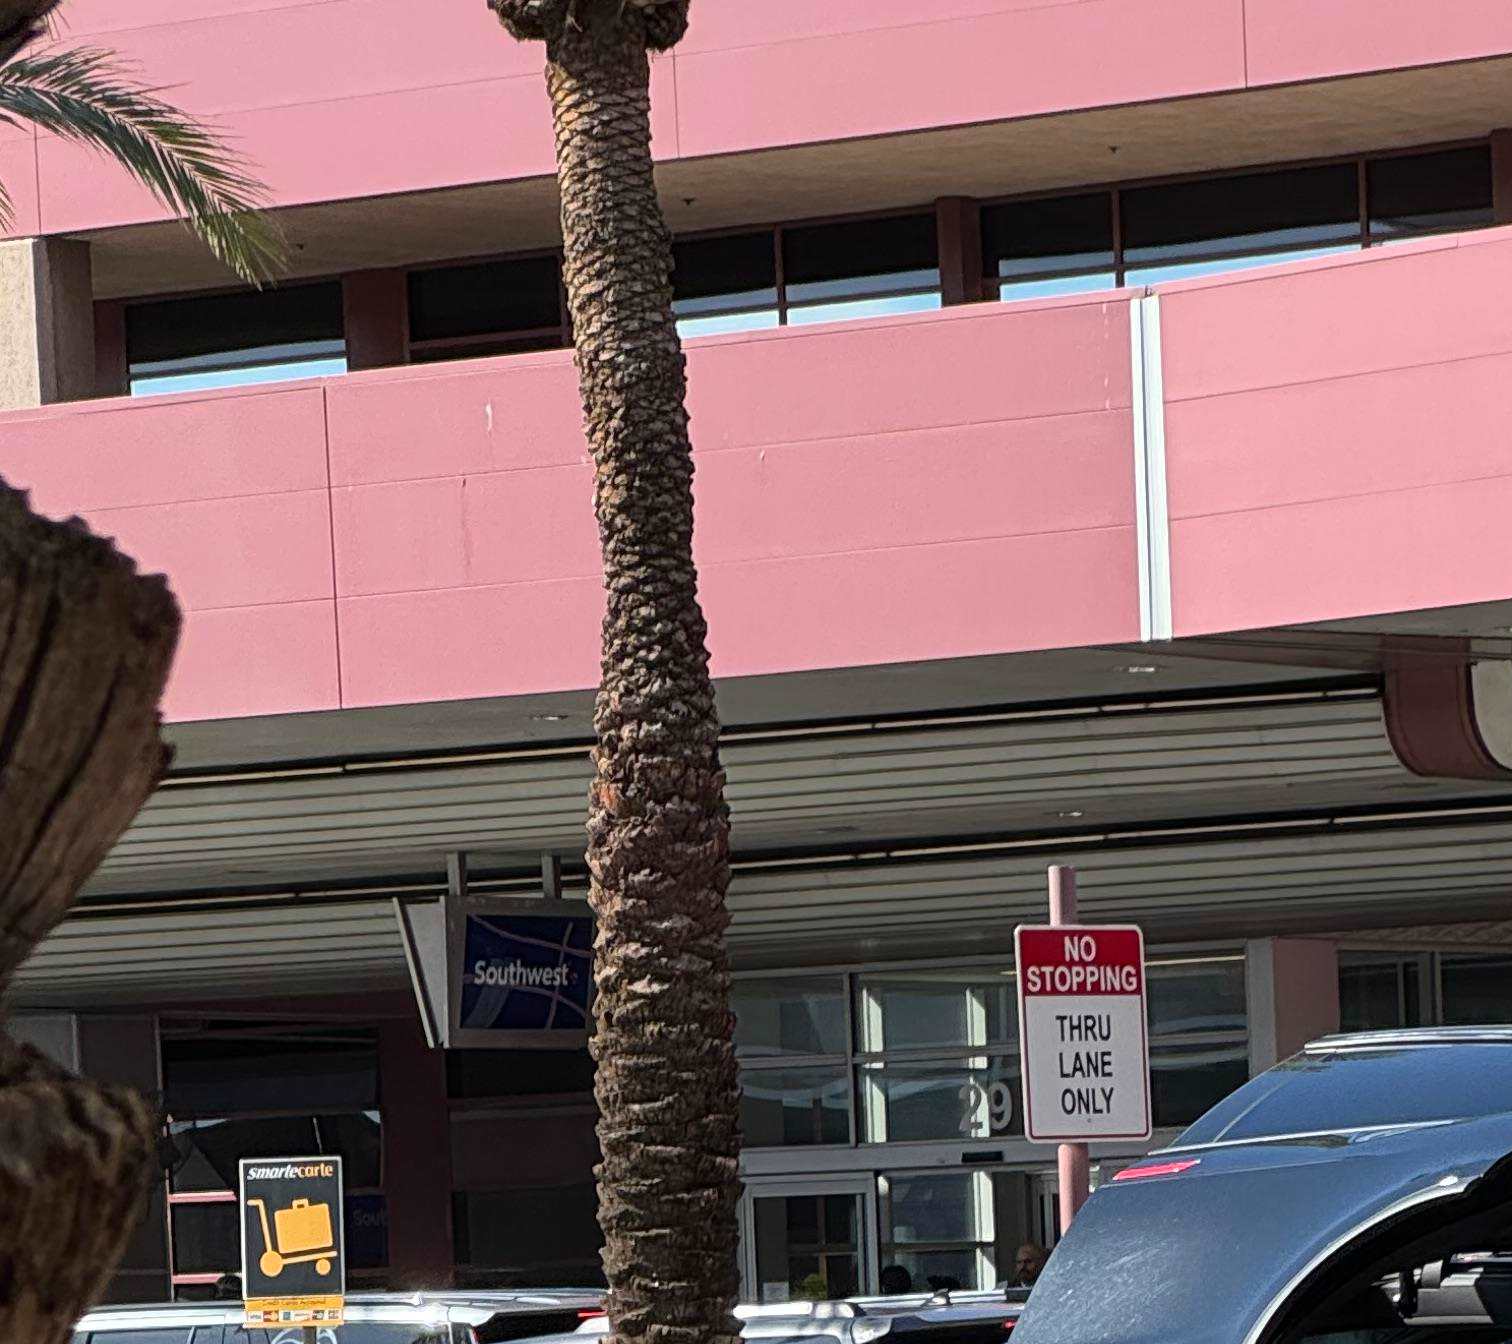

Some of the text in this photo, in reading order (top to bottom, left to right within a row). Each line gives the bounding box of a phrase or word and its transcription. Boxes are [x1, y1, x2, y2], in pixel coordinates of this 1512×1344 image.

[1063, 935, 1096, 962] NO
[473, 958, 570, 987] Southwest
[1026, 965, 1138, 992] STOPPING
[1055, 1013, 1112, 1042] THRU
[1059, 1051, 1114, 1078] LANE
[958, 1081, 1013, 1133] 29
[1061, 1086, 1115, 1115] ONLY
[246, 1162, 334, 1181] smartecarte
